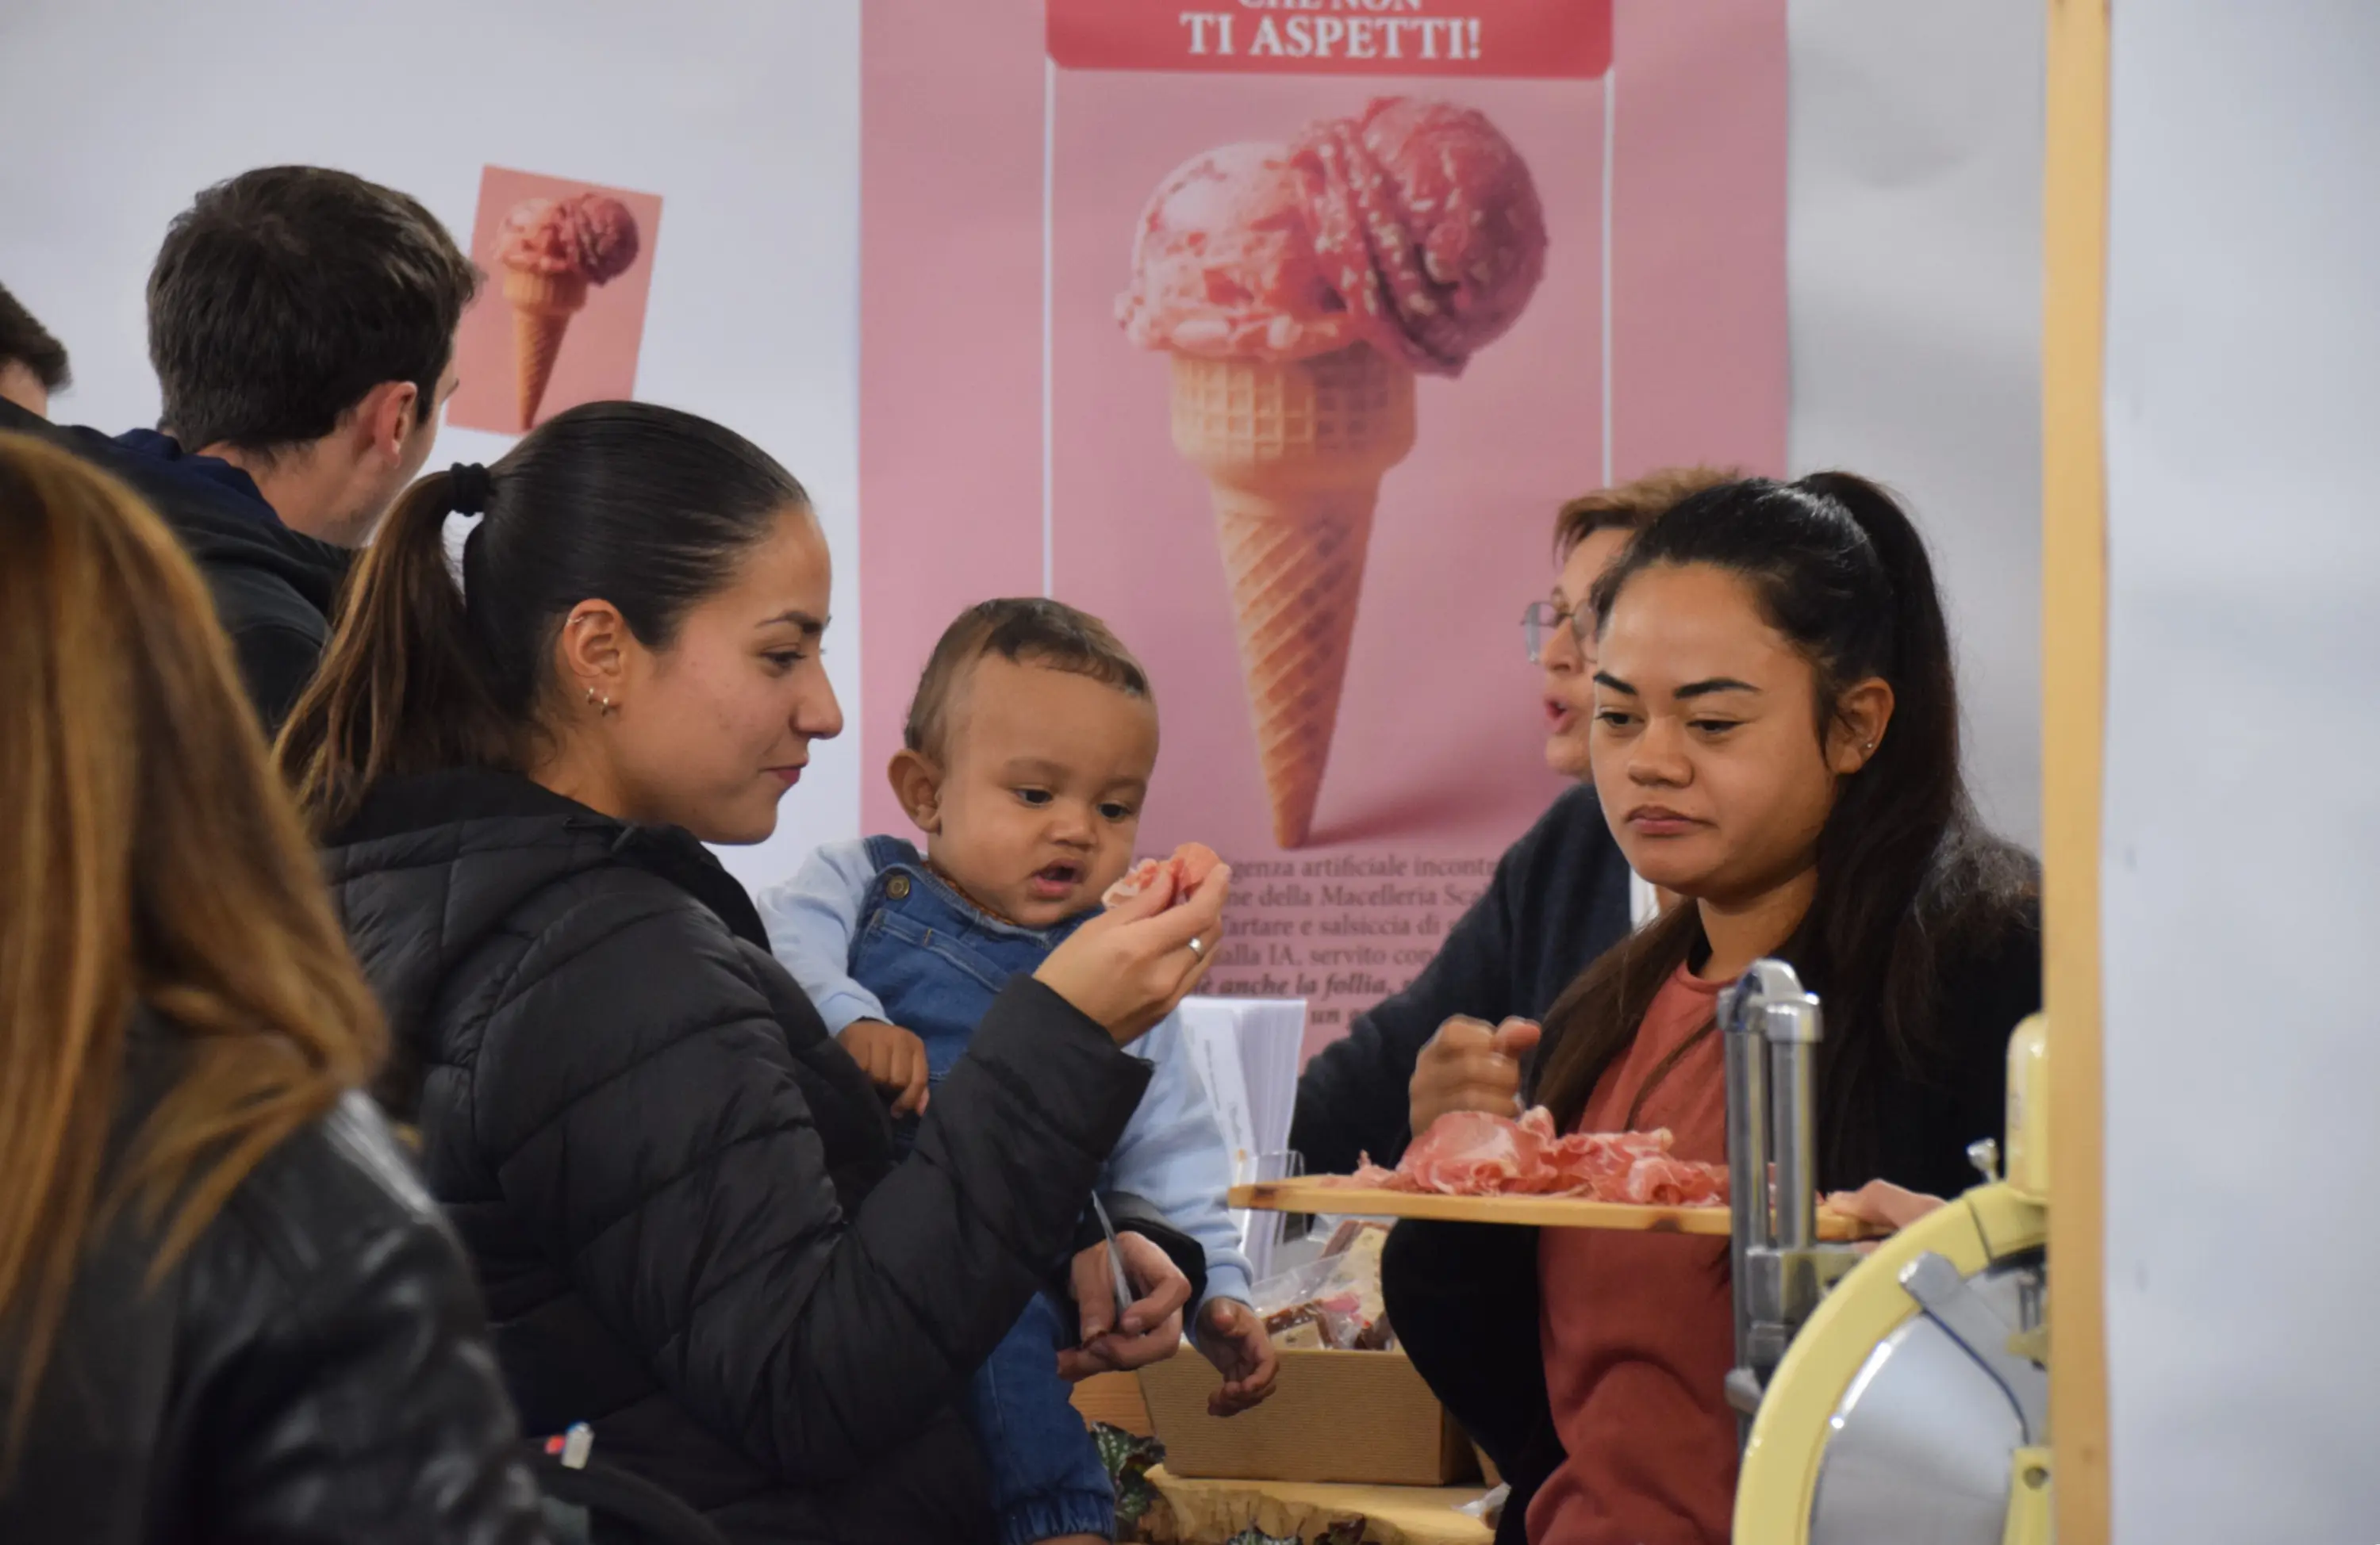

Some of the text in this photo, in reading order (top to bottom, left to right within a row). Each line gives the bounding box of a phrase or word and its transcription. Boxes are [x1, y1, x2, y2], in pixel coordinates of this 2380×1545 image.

[1179, 12, 1482, 59] TI ASPETTI!
[1230, 854, 1499, 884] genza artificiale incontr
[1258, 883, 1311, 907] della
[1319, 883, 1438, 907] Macelleria
[1299, 918, 1312, 936] e
[1319, 913, 1411, 937] salsiccia
[1416, 912, 1441, 936] di
[1211, 942, 1261, 966] alla
[1310, 943, 1387, 965] servito
[1219, 972, 1289, 995] anche
[1295, 972, 1318, 995] la
[1310, 1009, 1341, 1026] un
